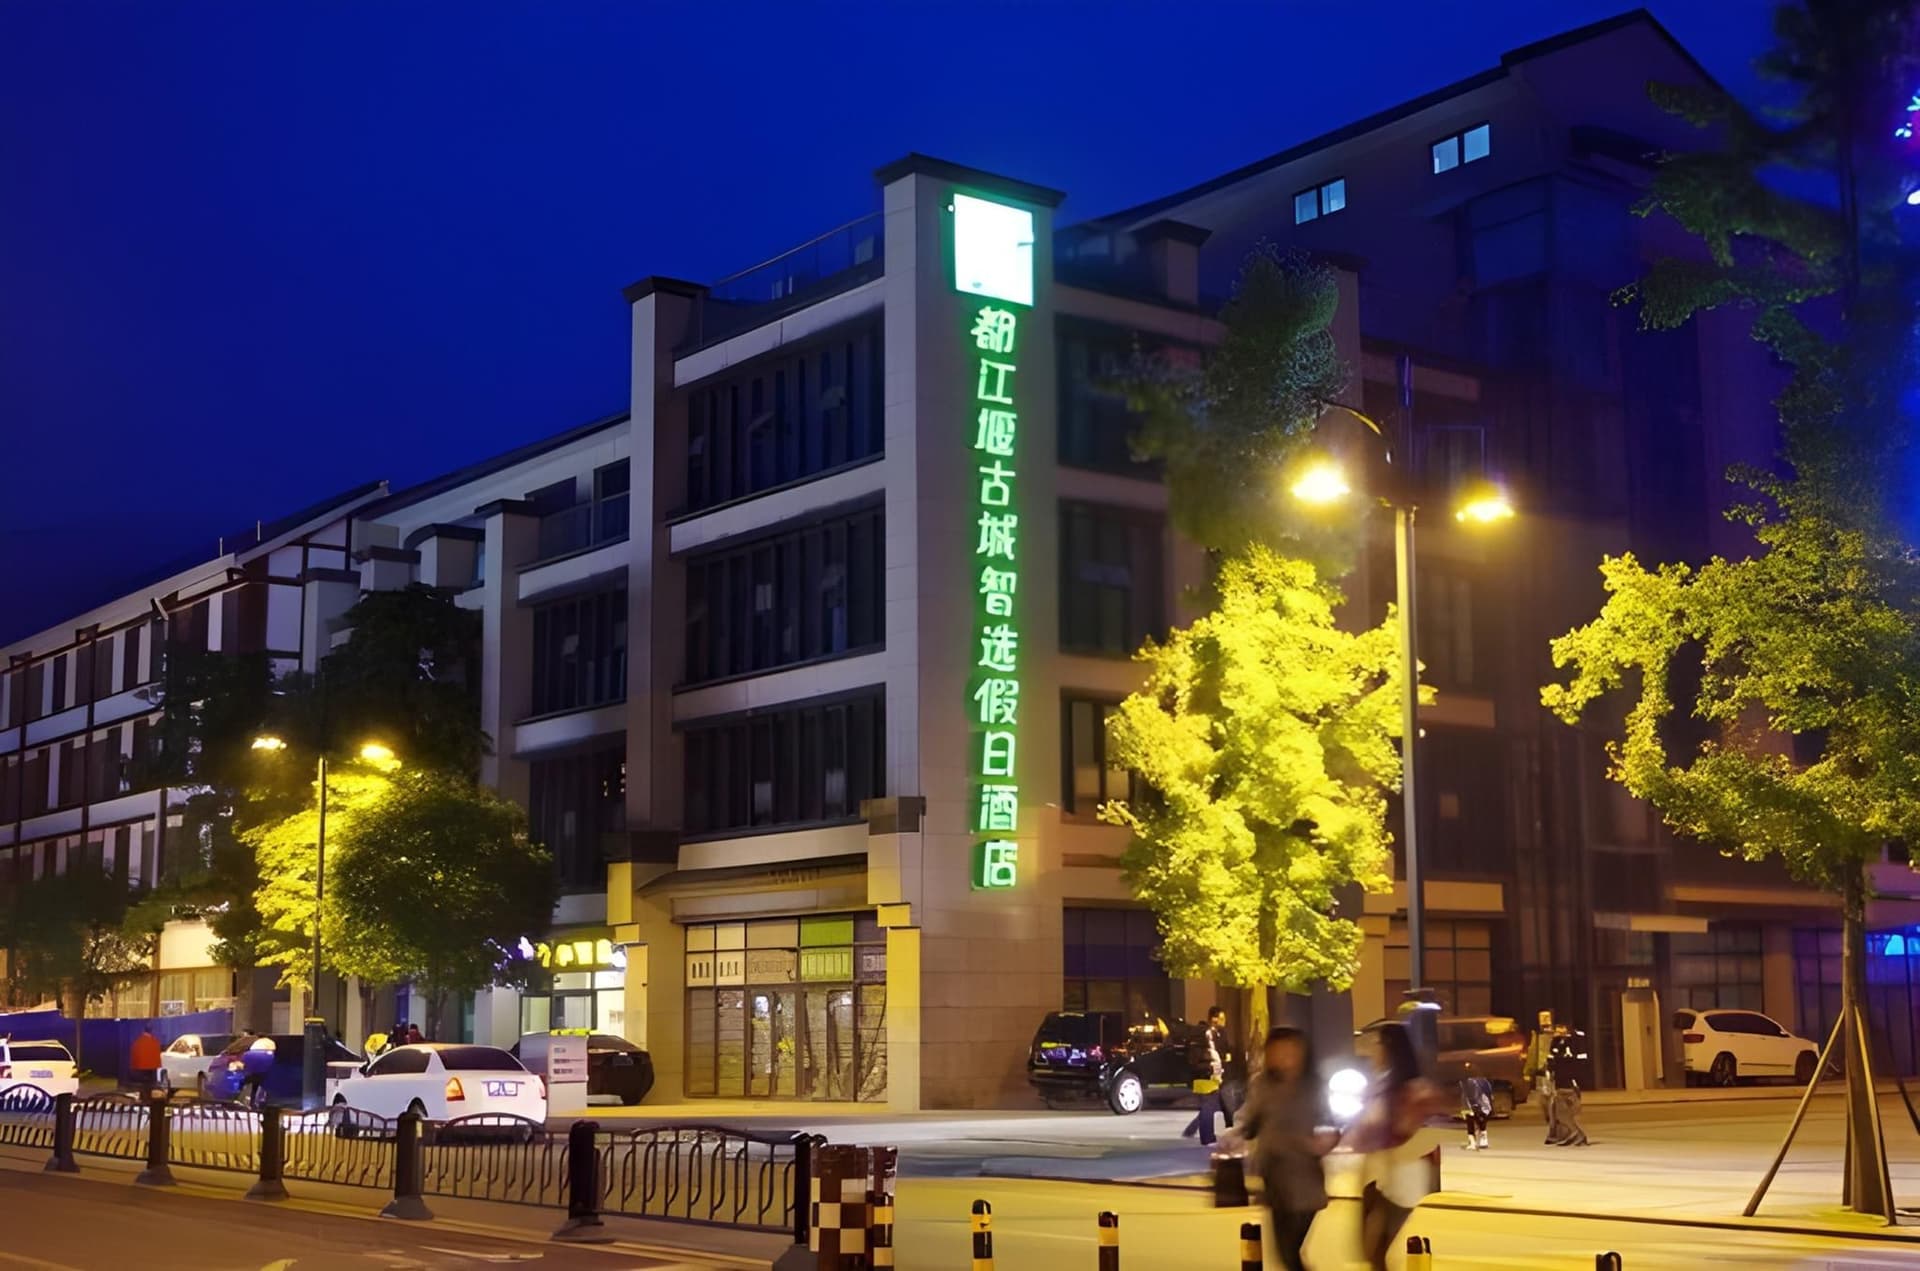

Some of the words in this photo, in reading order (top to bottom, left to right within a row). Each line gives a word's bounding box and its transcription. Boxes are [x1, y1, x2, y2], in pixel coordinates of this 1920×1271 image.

[971, 306, 1019, 887] 都江堰古城智选假日酒店
